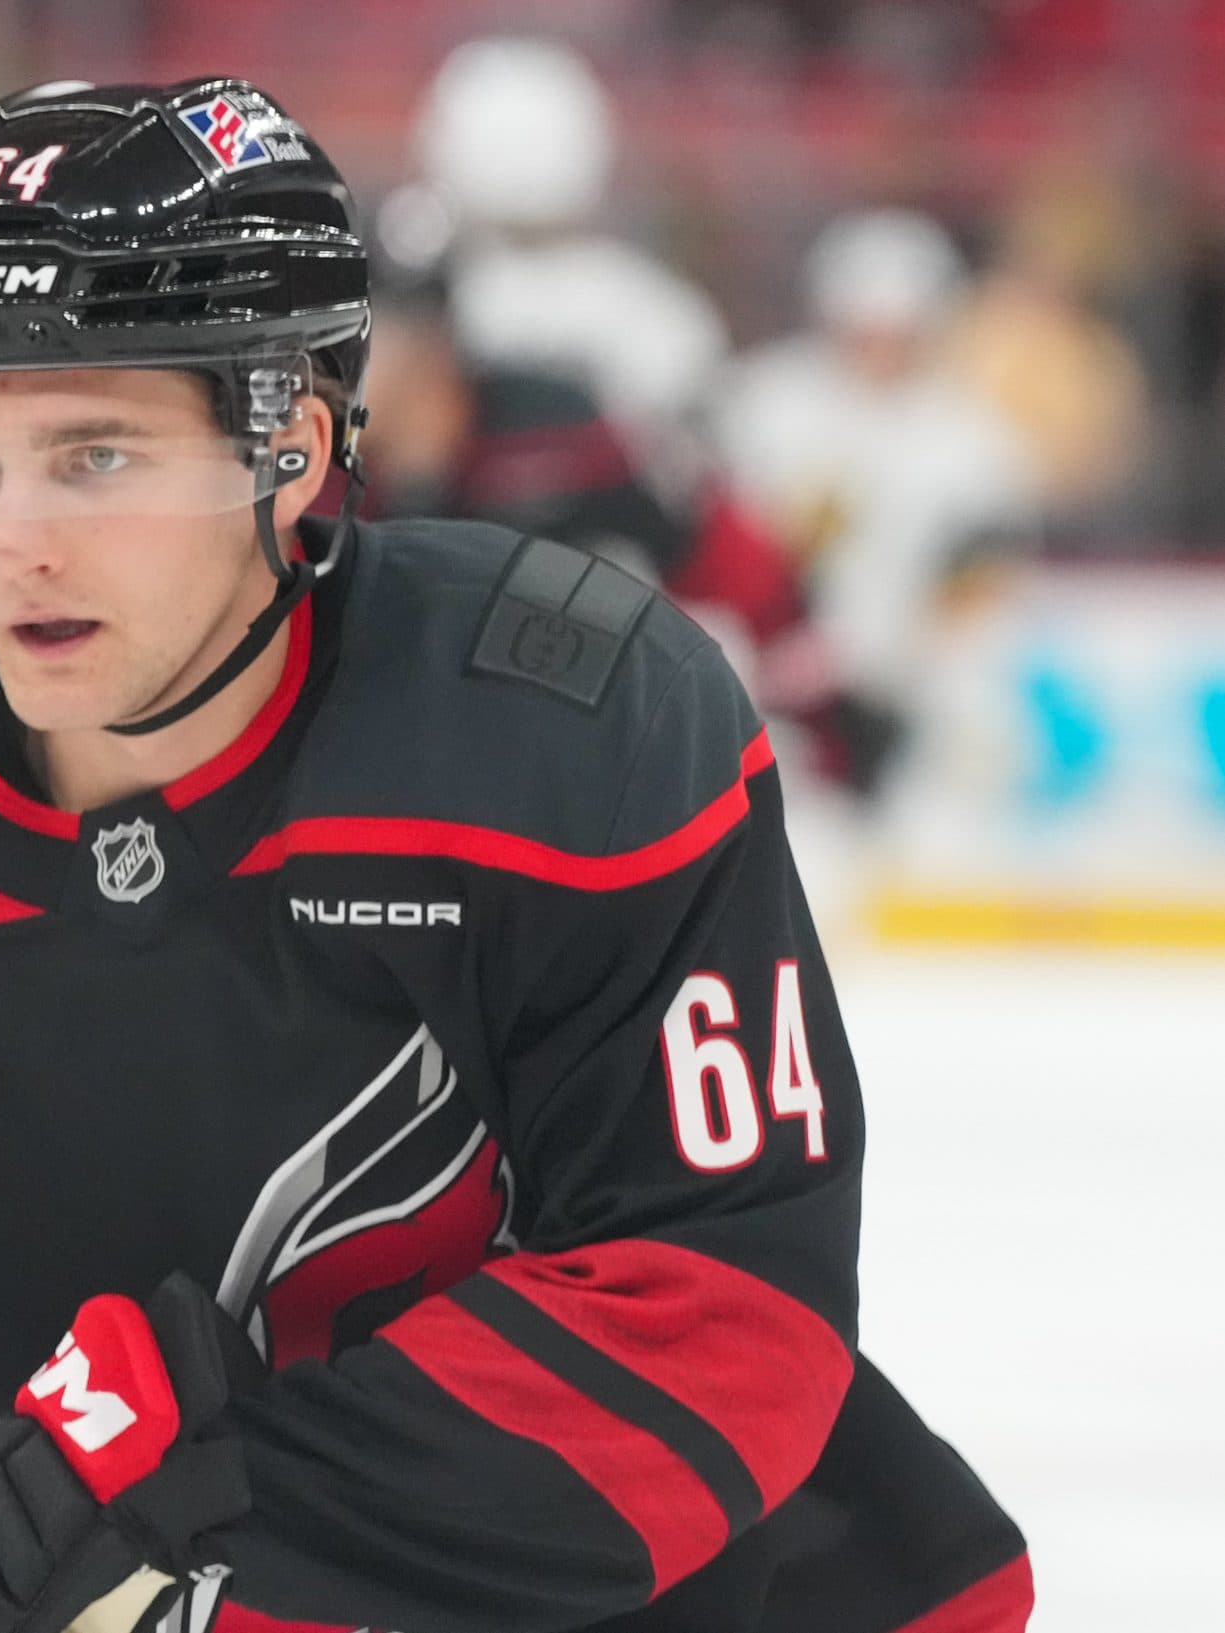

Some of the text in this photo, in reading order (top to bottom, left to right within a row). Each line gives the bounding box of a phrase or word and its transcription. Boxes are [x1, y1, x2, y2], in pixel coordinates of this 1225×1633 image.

[264, 133, 311, 161] Bank
[114, 840, 147, 889] NHL
[290, 898, 462, 926] NUCOR
[660, 957, 830, 1176] 64
